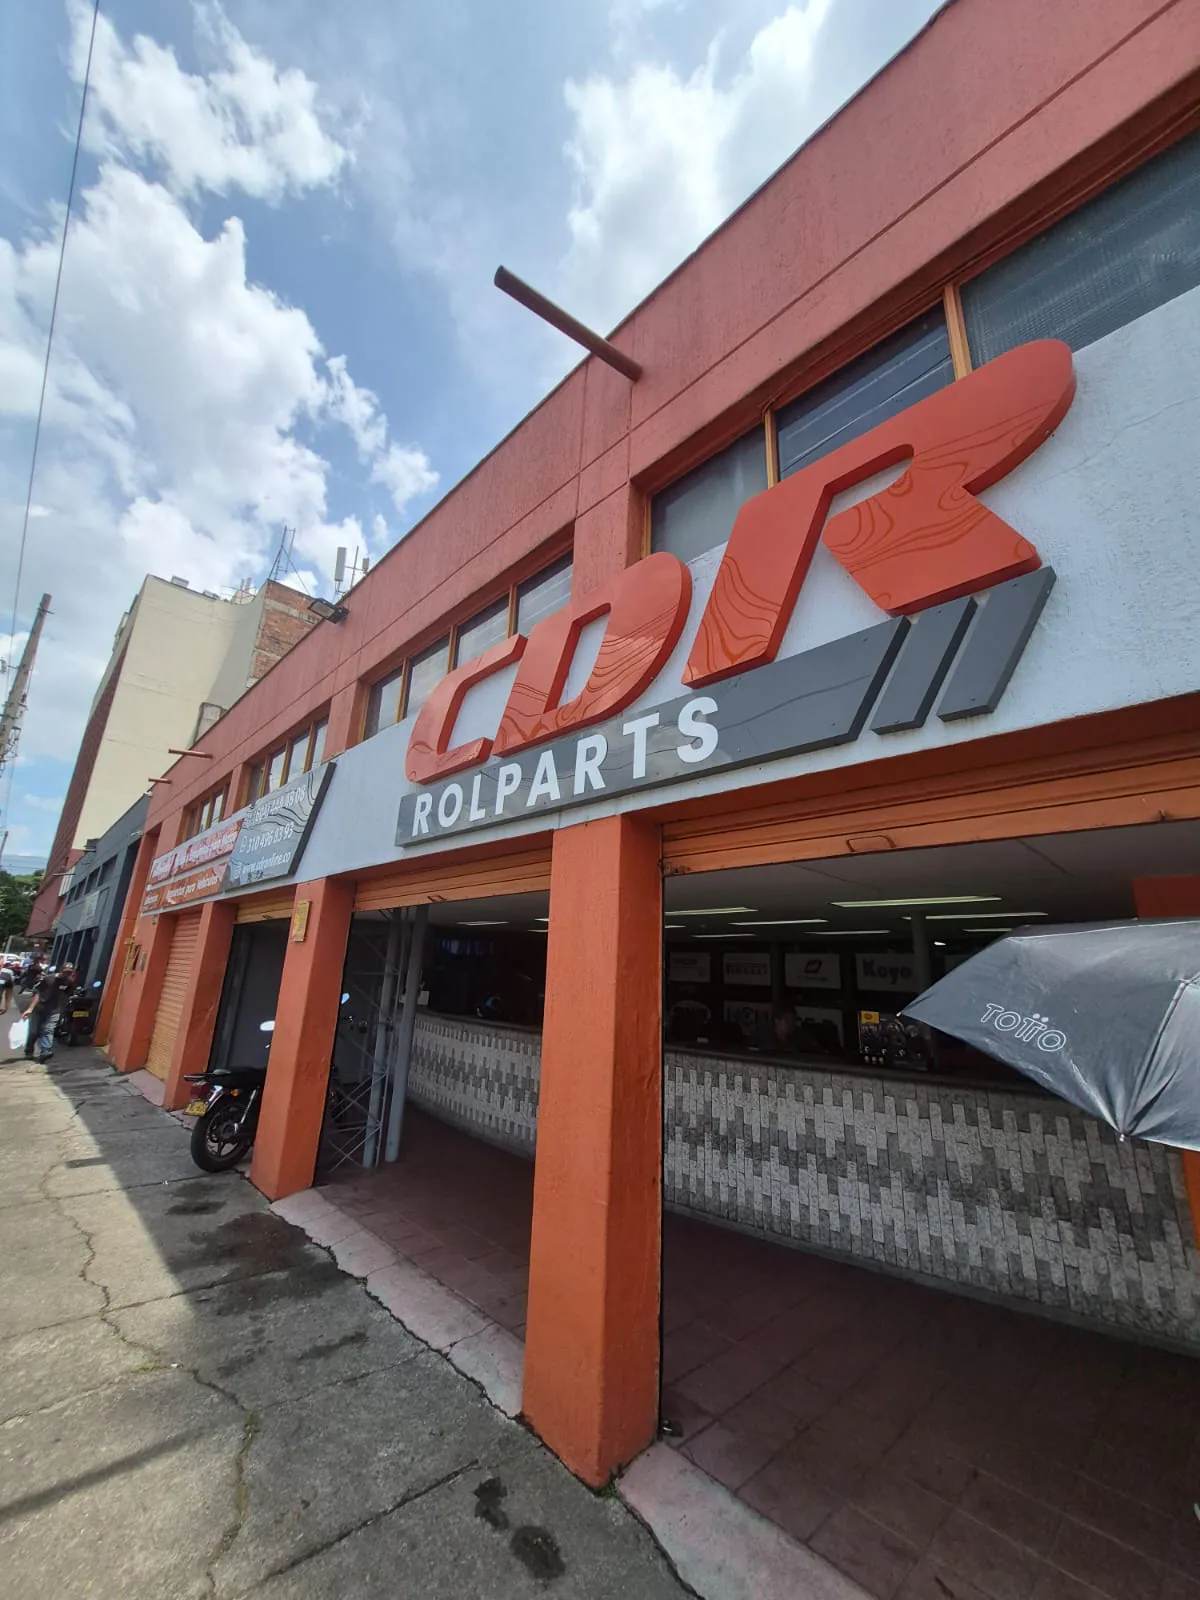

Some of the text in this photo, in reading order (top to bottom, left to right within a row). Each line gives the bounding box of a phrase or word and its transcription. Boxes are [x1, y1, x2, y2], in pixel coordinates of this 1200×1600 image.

[405, 338, 1076, 785] CDR
[411, 697, 720, 837] ROLPARTS
[246, 835, 260, 853] 310
[283, 821, 294, 840] 93
[862, 957, 912, 985] Koyo
[980, 1003, 1067, 1052] TOTTO
